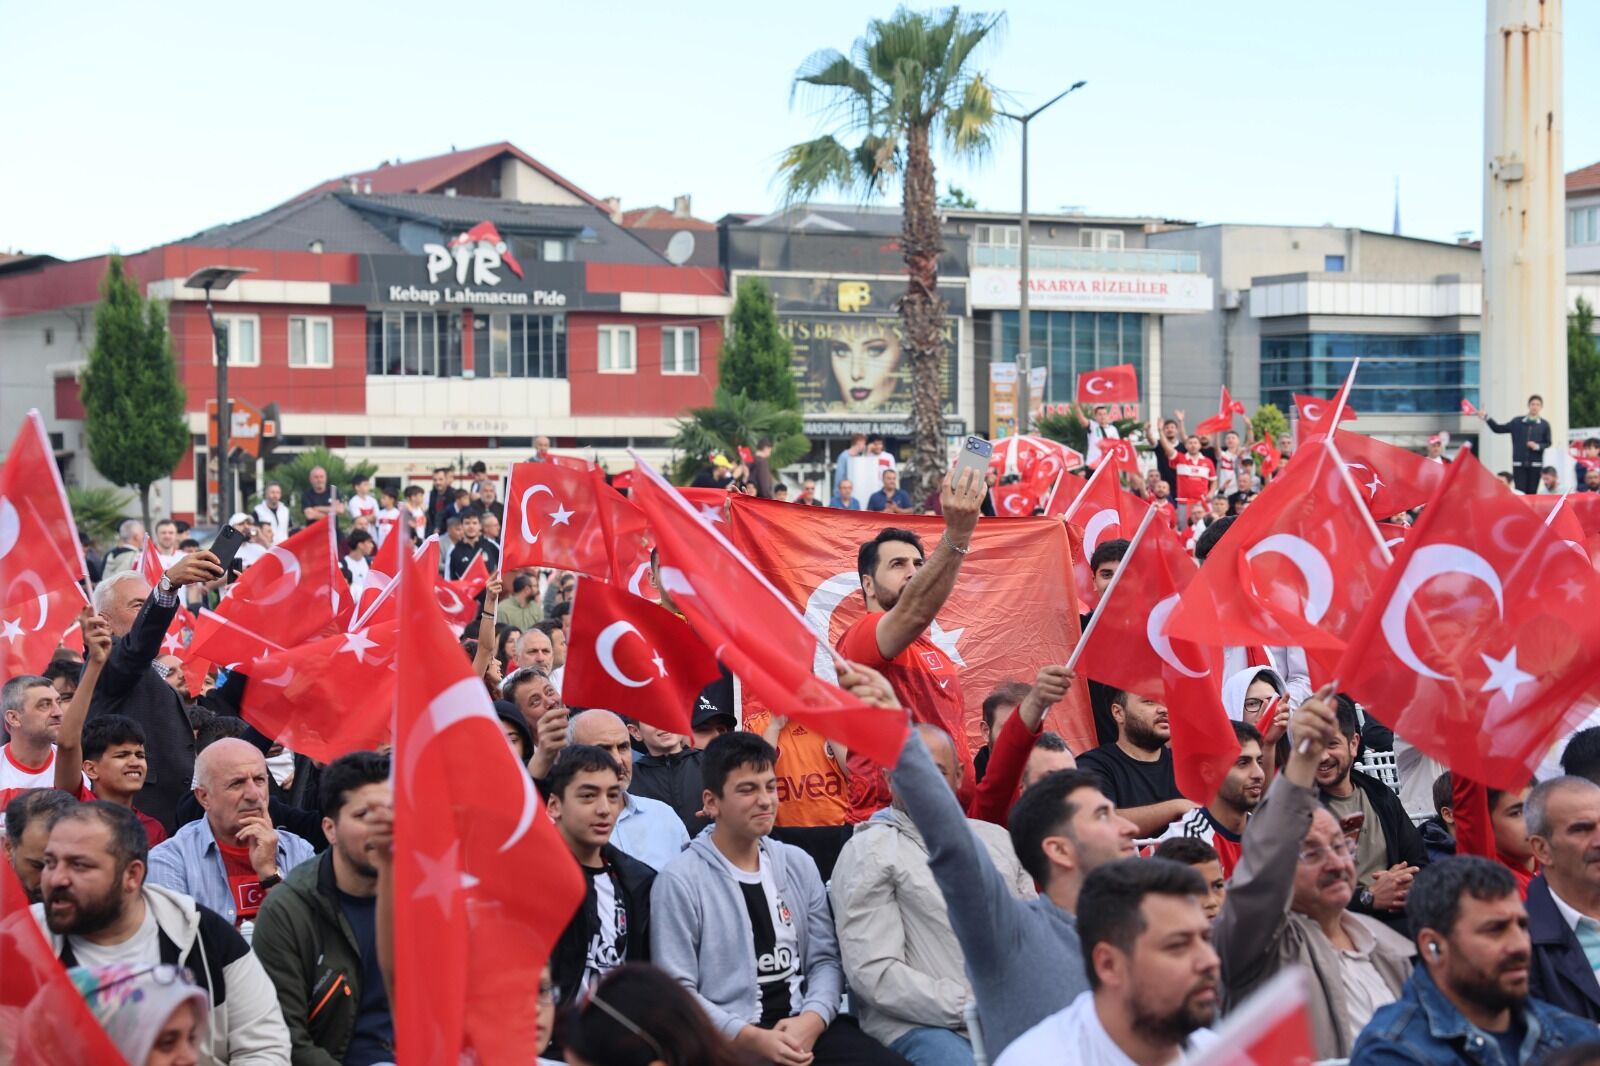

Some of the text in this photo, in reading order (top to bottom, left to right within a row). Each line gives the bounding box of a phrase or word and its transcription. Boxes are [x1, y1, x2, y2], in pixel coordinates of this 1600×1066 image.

[389, 285, 567, 306] Kebap Lahmacun Pide
